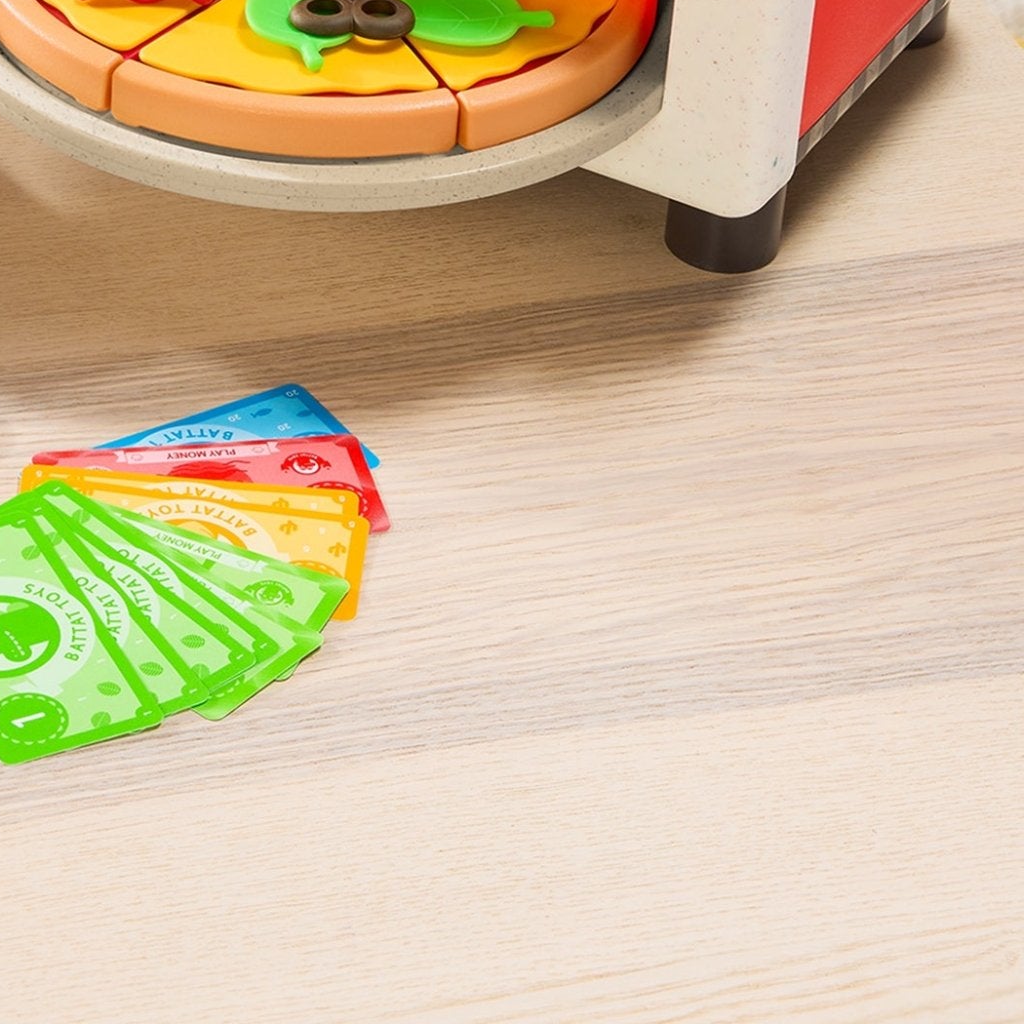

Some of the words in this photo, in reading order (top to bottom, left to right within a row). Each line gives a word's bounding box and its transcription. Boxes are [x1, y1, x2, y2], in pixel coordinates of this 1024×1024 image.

[163, 429, 234, 445] BATTAT
[166, 449, 212, 460] MONEY
[213, 448, 236, 458] PLAY
[139, 504, 185, 519] TOY
[190, 504, 257, 538] BATTAT
[154, 532, 195, 551] MONEY
[194, 545, 221, 560] PLAY
[23, 583, 69, 610] TOYS
[64, 610, 87, 661] BATTAT
[11, 711, 46, 729] 1
